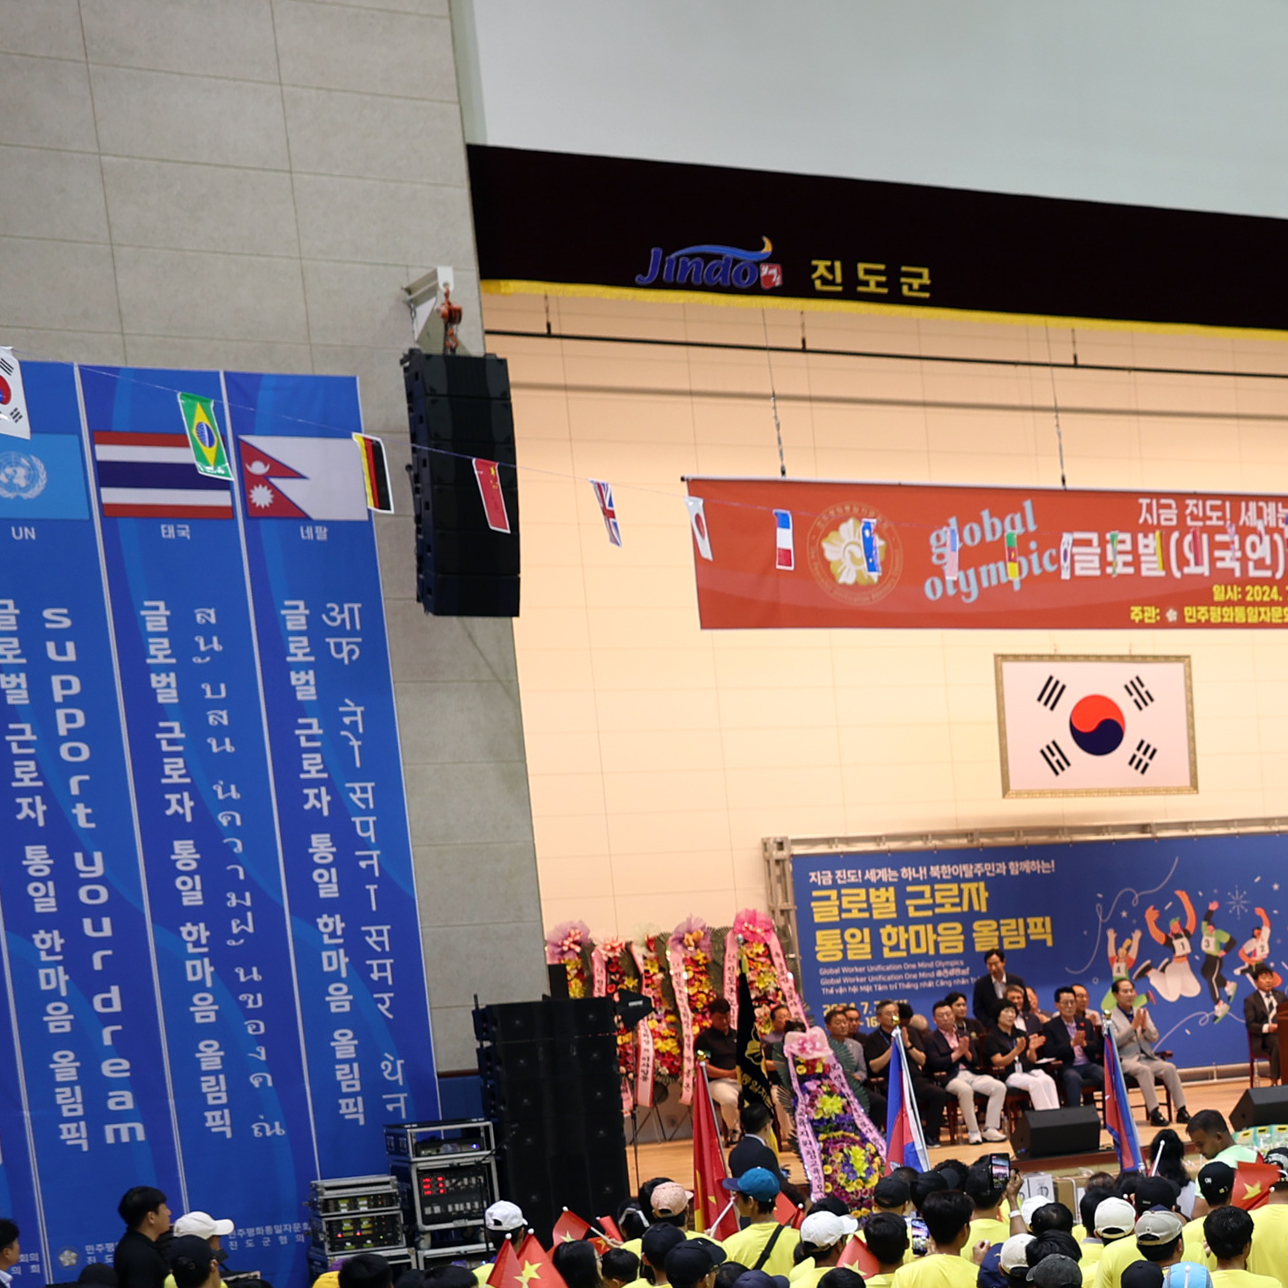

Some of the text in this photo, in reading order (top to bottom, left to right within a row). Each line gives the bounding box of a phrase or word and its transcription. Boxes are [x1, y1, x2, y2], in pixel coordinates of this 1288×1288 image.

[635, 247, 760, 288] Jindo
[811, 259, 931, 298] 진도군
[11, 526, 36, 541] UN
[161, 524, 191, 542] 태국
[929, 499, 1038, 565] global
[1138, 498, 1178, 526] 지금
[1185, 499, 1230, 527] 진도!
[924, 540, 1060, 603] olympic
[1212, 585, 1242, 602] 일시:
[1245, 585, 1283, 602] 2024.
[5, 723, 47, 827] 근로자
[22, 845, 57, 913] 통일
[42, 608, 146, 1144] support your dream
[140, 600, 233, 1139] 글로벌 근로자 통일 한마음 올림픽
[281, 600, 366, 1126] 글로벌 근로자 통일 한마음 올림픽
[808, 870, 833, 886] 지금
[835, 868, 862, 885] 진도!
[864, 866, 899, 884] 세계는
[900, 865, 927, 881] 하나!
[810, 881, 989, 923] 글로벌 근로자
[815, 916, 1053, 963] 통일 한마음 올림픽
[32, 929, 75, 1034] 한마음
[49, 1049, 89, 1152] 올림픽
